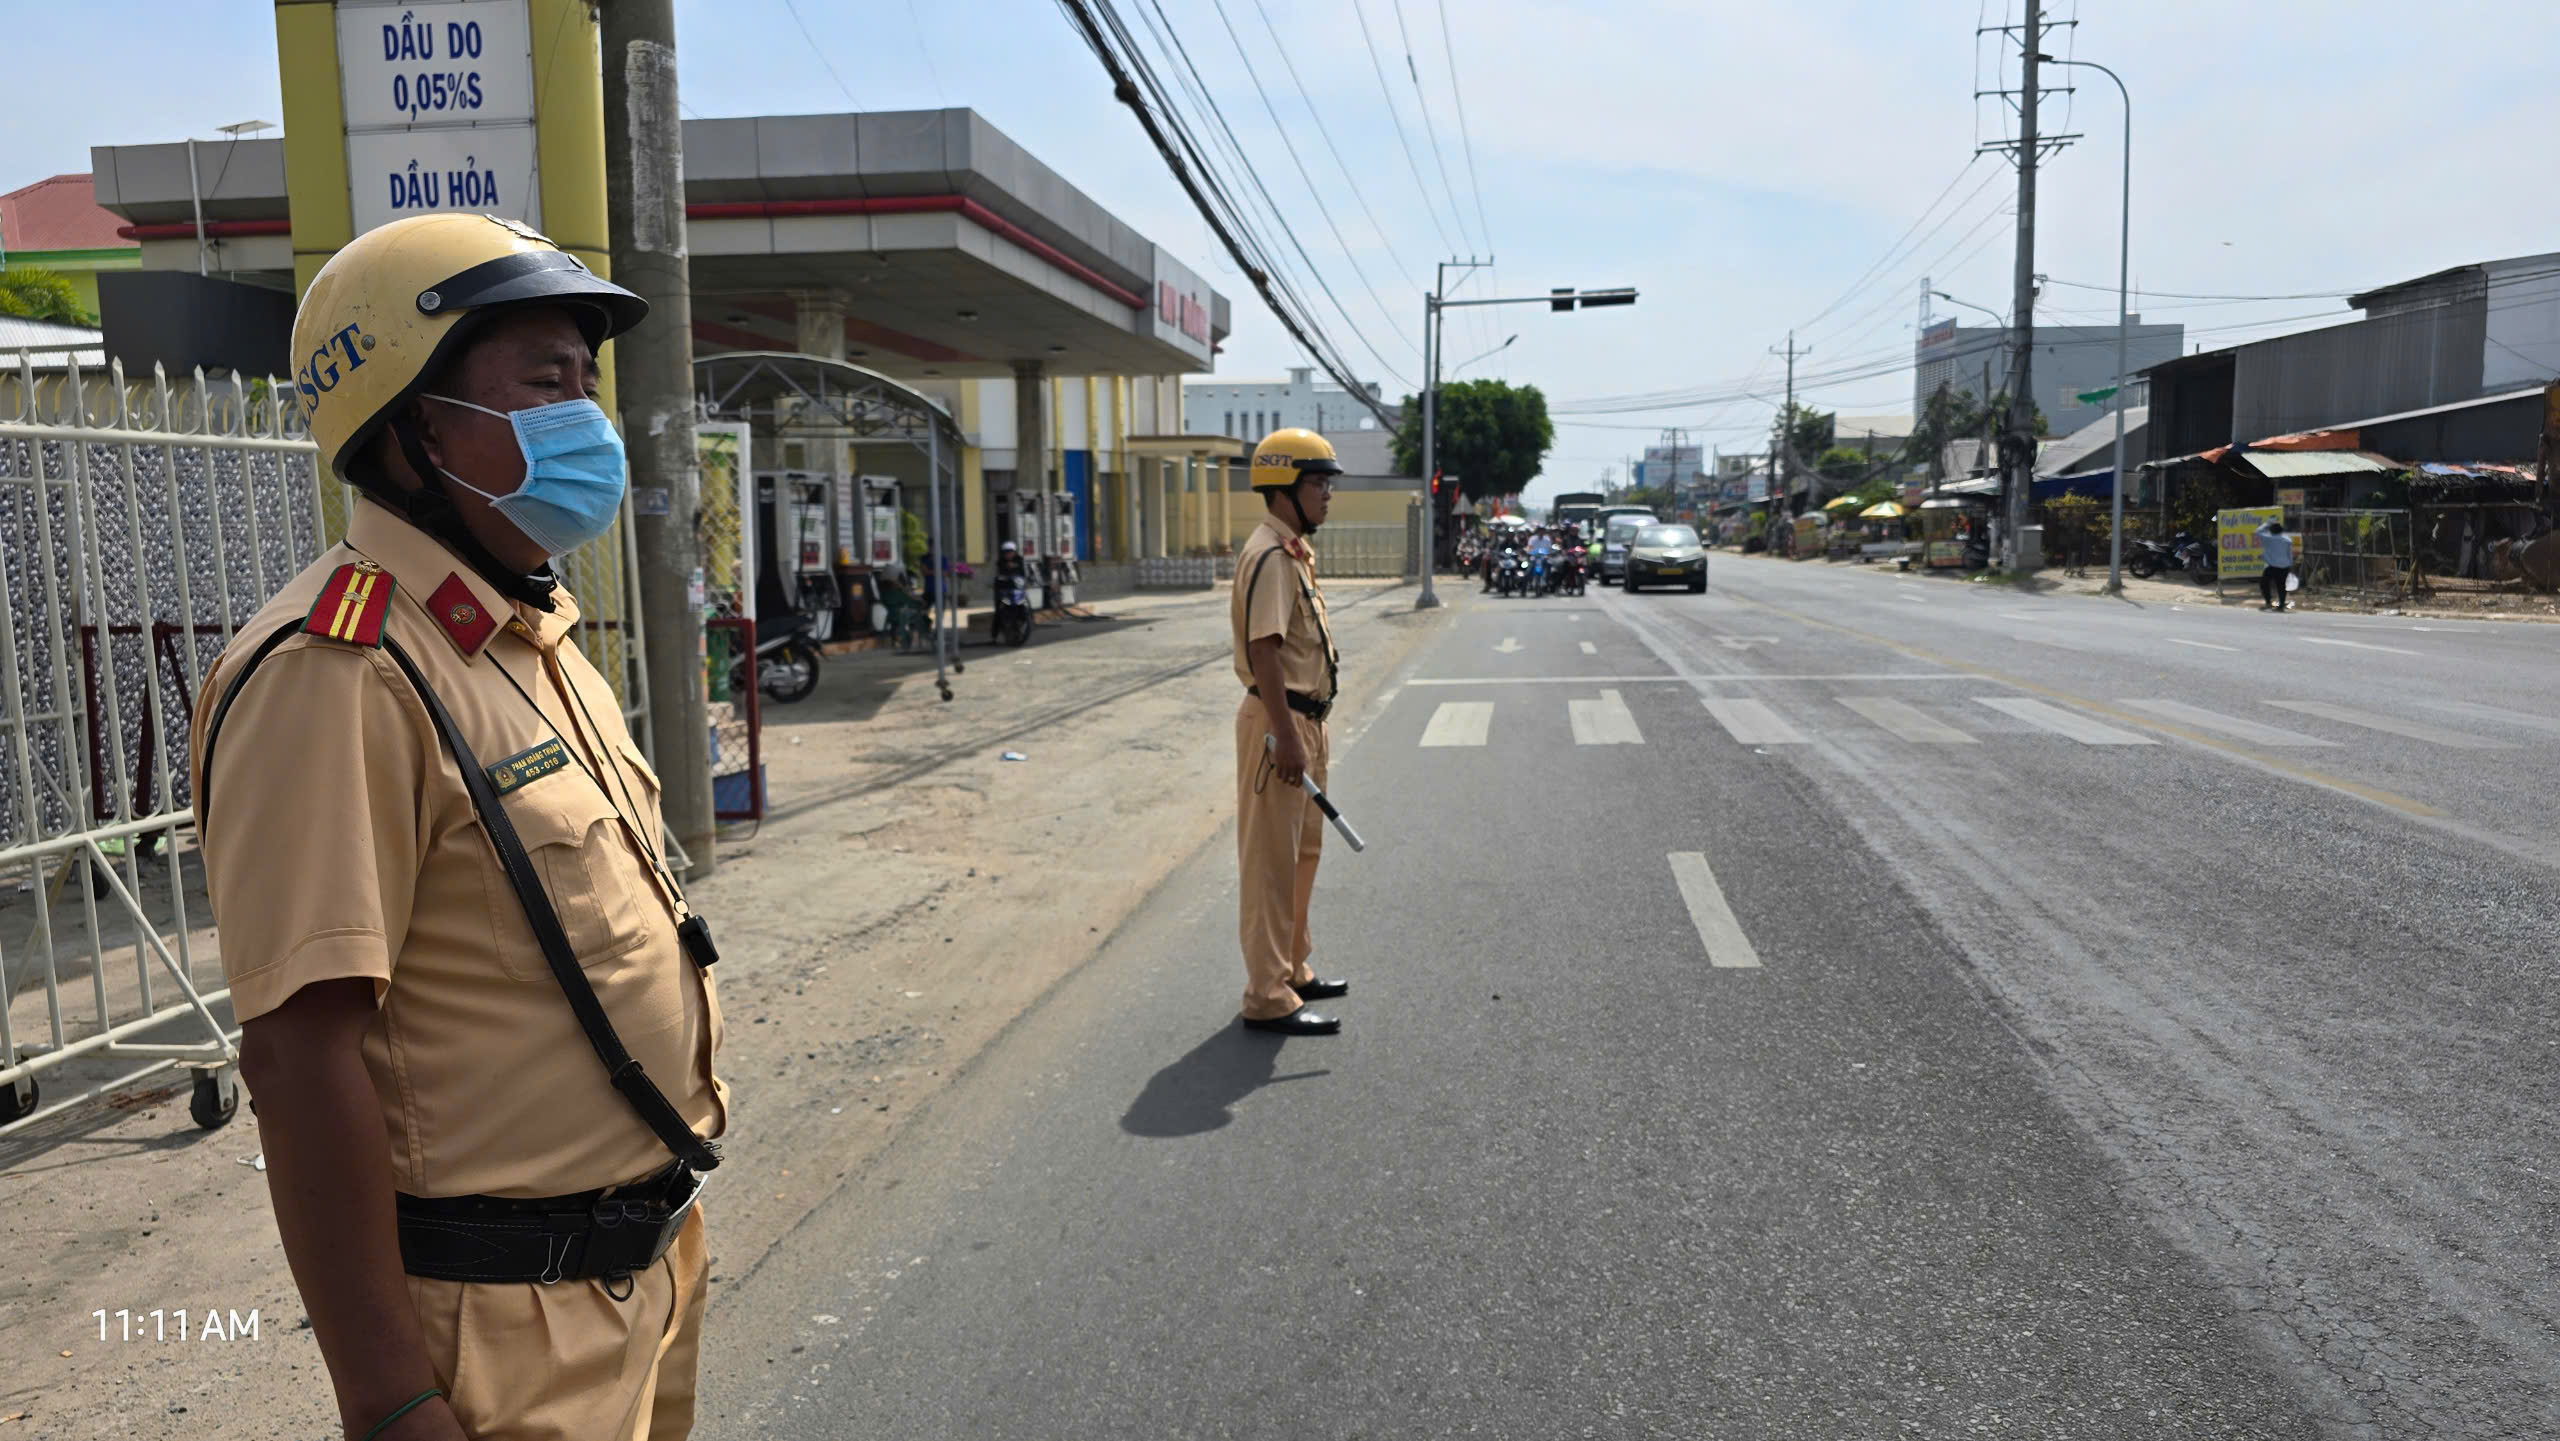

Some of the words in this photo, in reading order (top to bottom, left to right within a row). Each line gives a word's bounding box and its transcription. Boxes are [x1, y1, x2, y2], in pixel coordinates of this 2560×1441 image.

[382, 10, 434, 61] DẦU
[447, 20, 483, 60] DO
[393, 71, 484, 122] 0,05%S
[389, 158, 440, 210] DẦU
[447, 155, 499, 208] HỎA
[1255, 455, 1293, 467] CSGT
